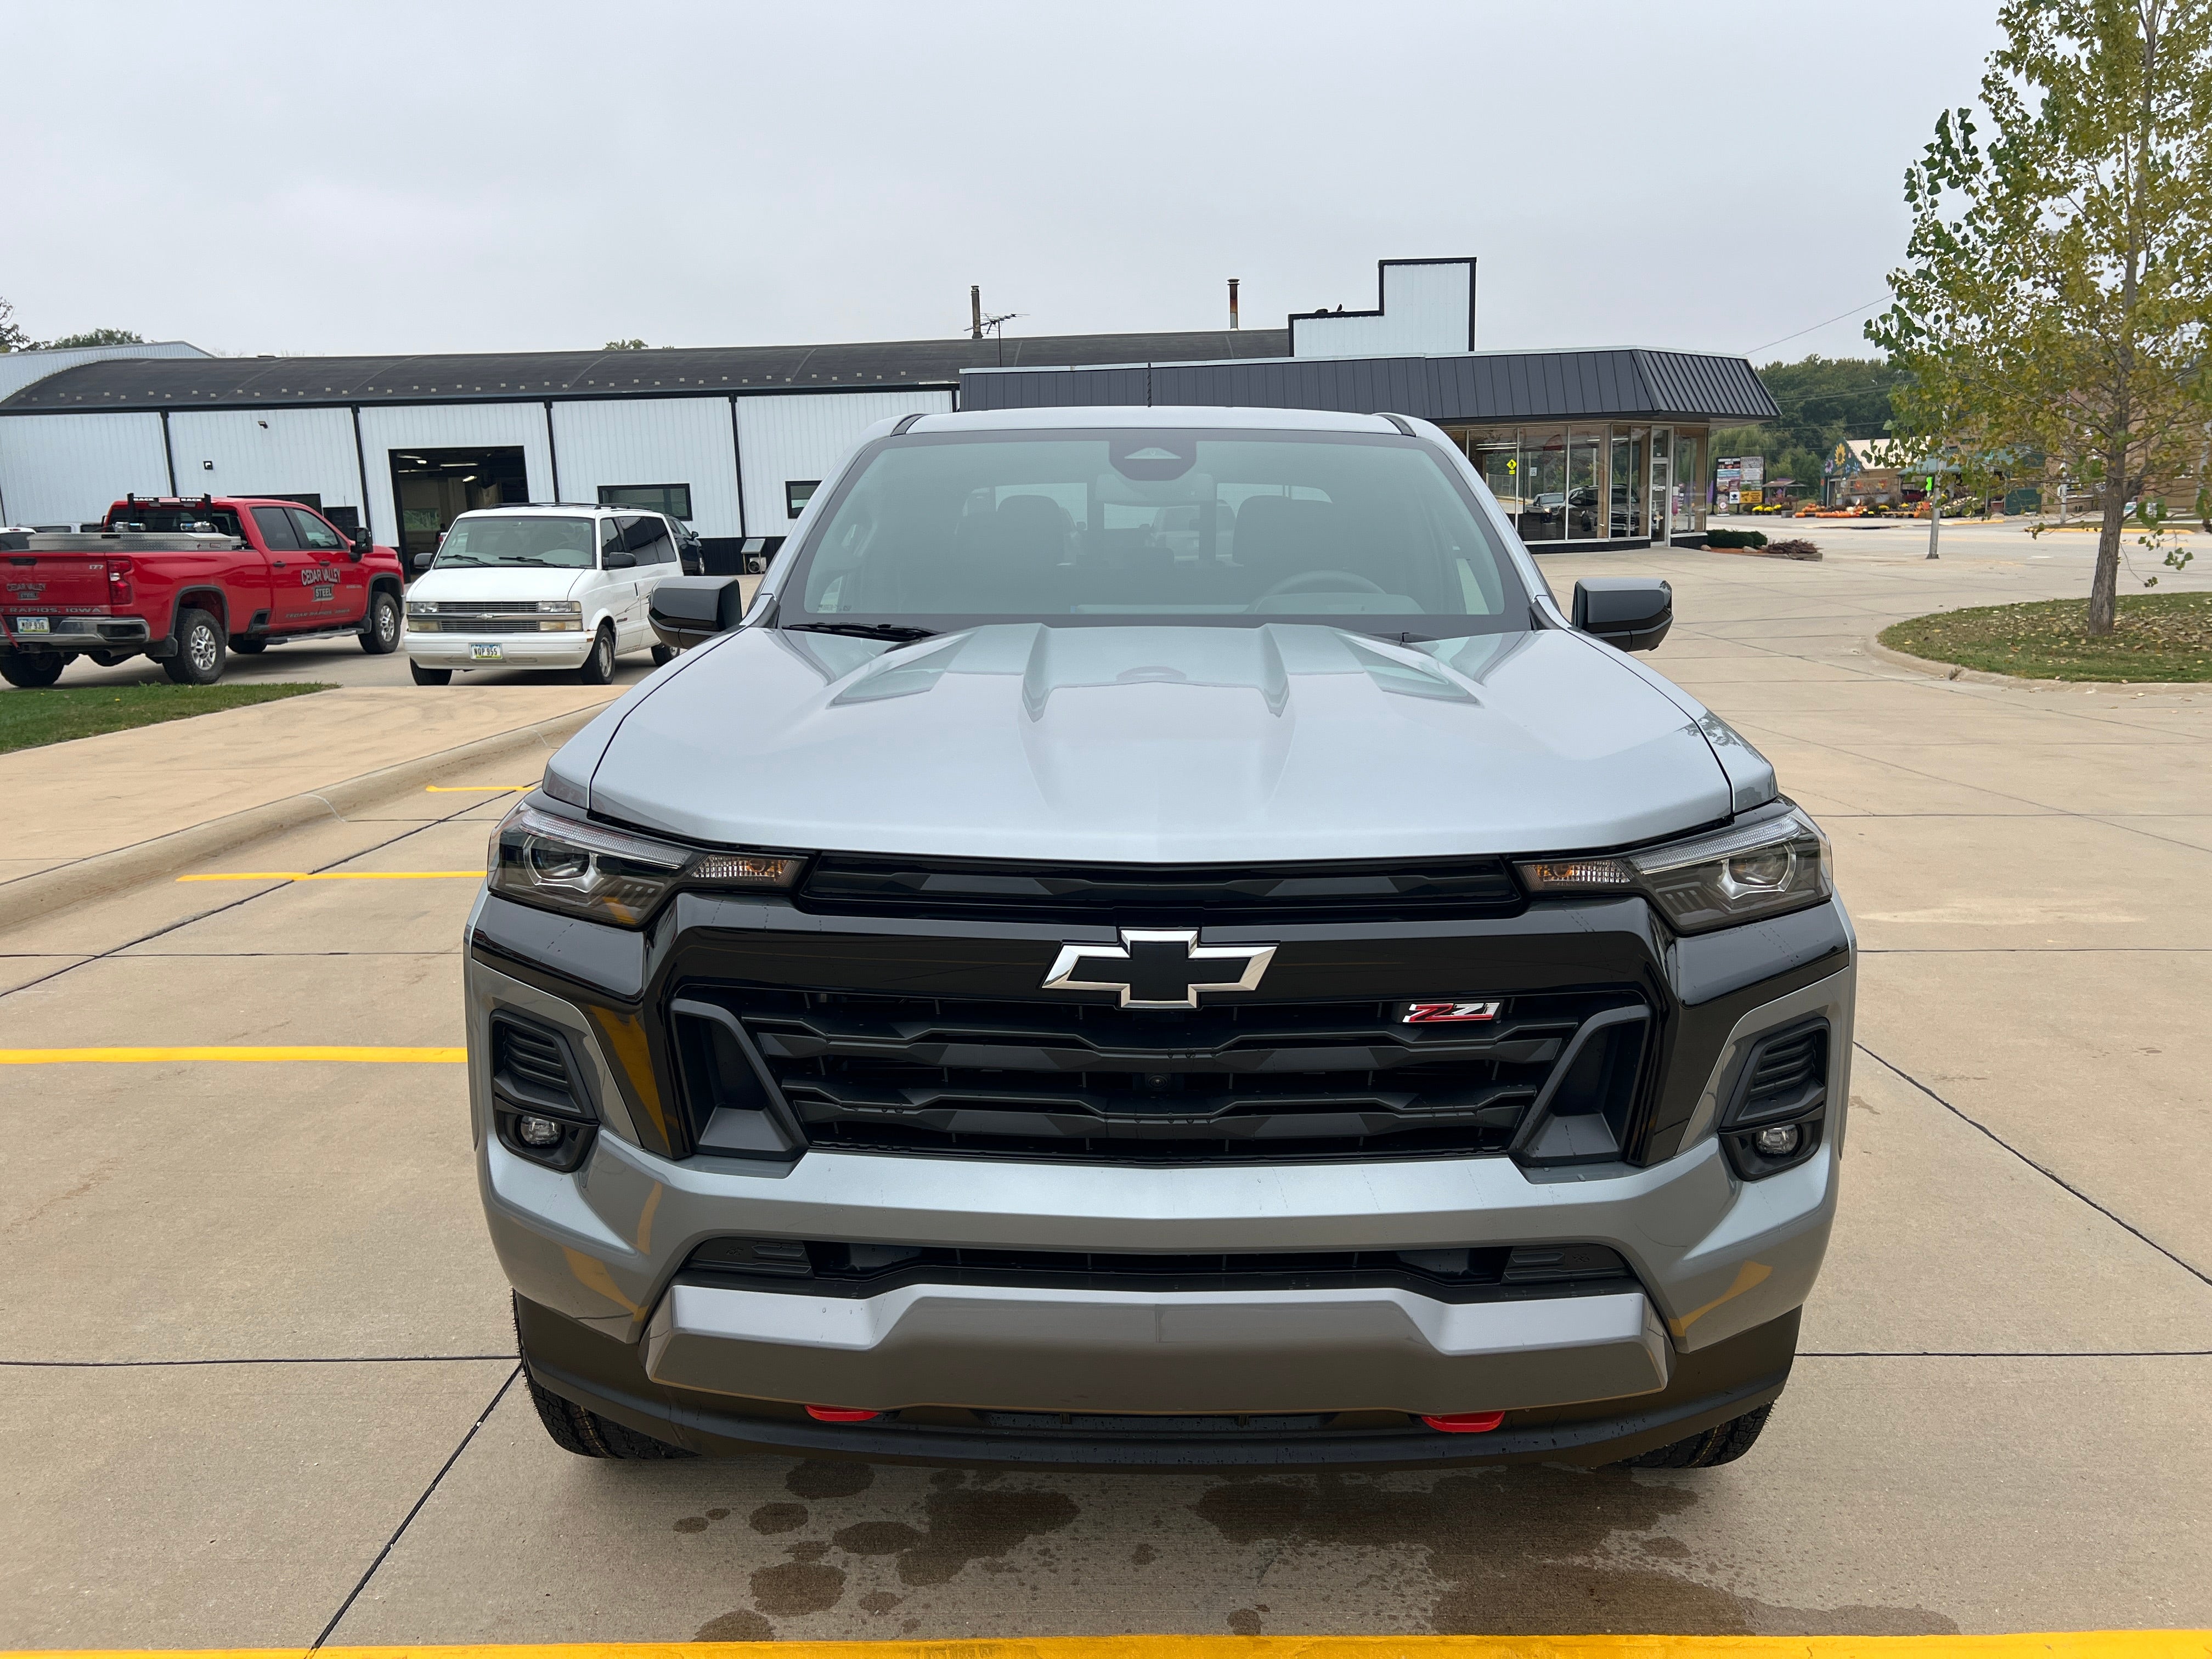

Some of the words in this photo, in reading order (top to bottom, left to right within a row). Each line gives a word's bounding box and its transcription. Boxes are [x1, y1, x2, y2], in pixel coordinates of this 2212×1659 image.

[301, 569, 321, 586] CEDAR
[321, 568, 340, 584] VALLEY
[315, 588, 332, 597] STEEL
[487, 647, 498, 656] 955
[1402, 1002, 1500, 1023] Z71
